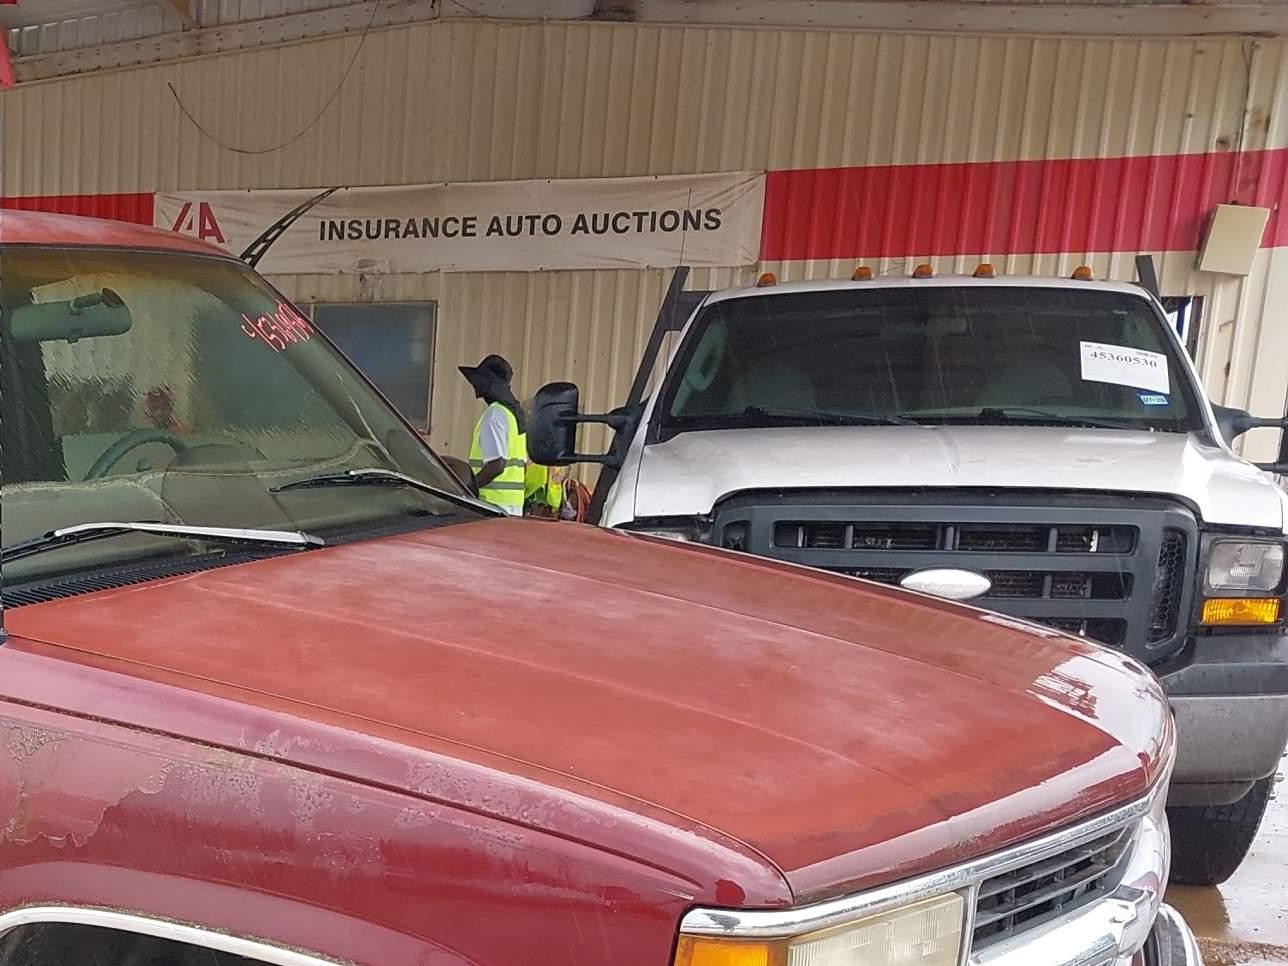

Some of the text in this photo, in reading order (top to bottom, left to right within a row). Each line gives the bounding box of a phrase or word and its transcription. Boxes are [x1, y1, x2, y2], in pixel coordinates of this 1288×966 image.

[319, 208, 723, 241] INSURANCE AUTO AUCTIONS
[1089, 350, 1158, 368] 45360530
